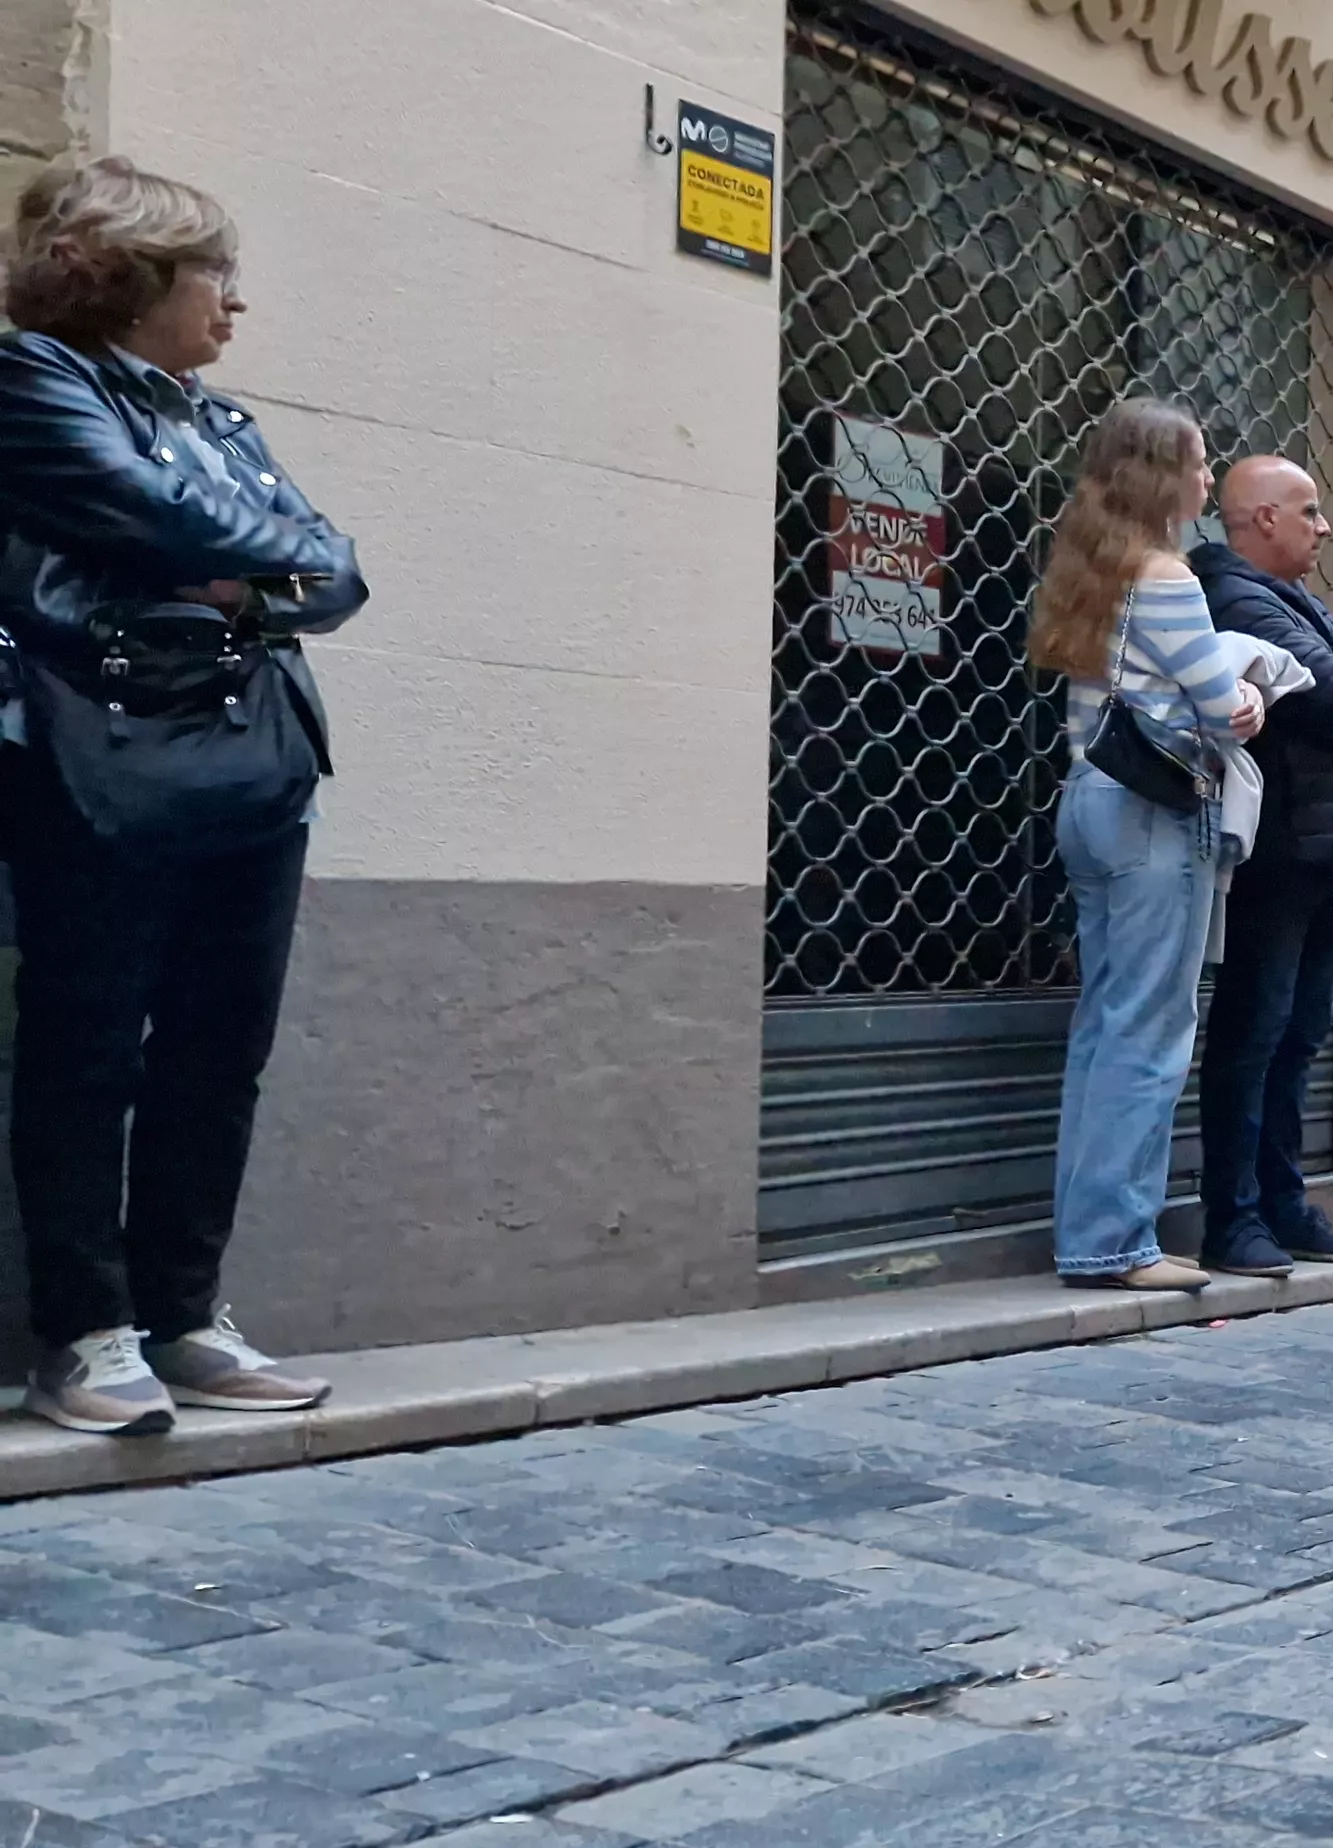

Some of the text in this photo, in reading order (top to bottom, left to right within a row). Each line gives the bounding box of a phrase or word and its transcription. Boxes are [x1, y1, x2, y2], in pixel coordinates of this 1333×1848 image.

[687, 164, 765, 200] CONECTADA
[851, 543, 922, 580] LOCAL
[833, 594, 866, 619] 974
